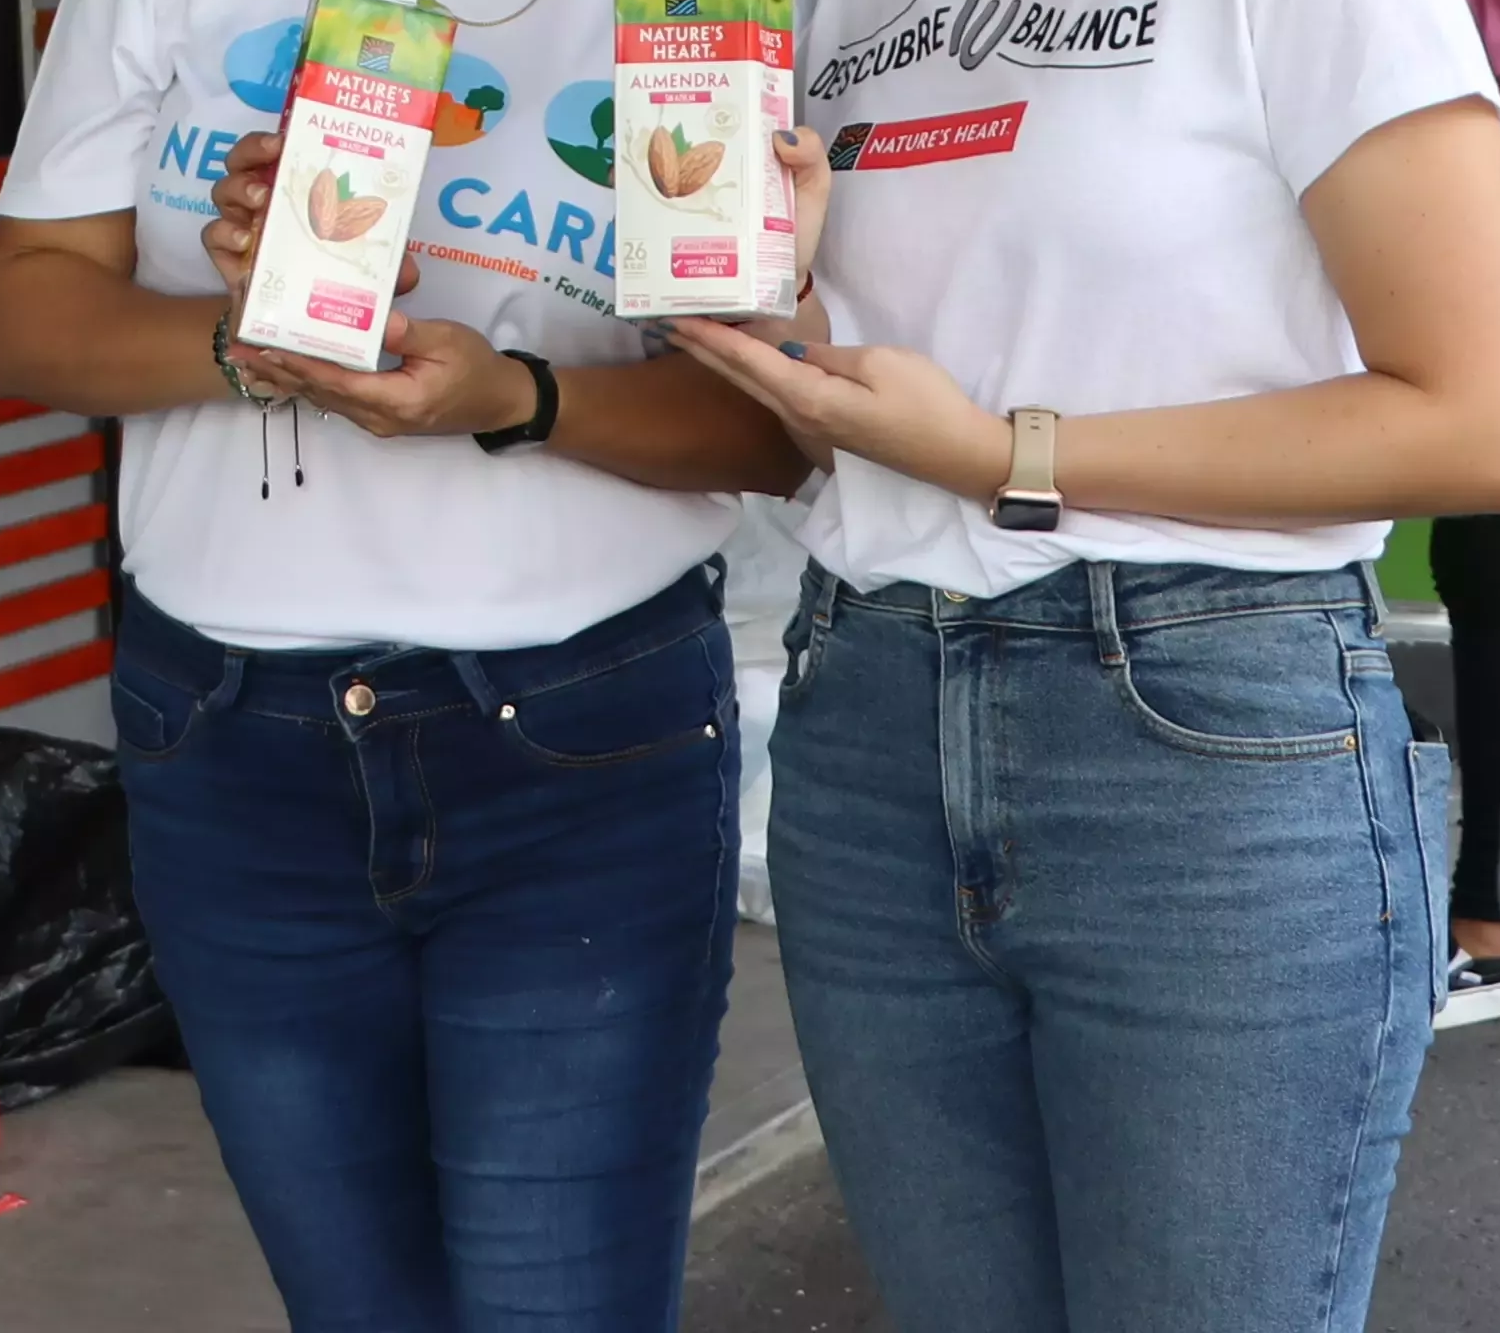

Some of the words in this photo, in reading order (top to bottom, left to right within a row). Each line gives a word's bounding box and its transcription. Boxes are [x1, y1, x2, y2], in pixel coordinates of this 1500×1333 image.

[639, 25, 724, 43] NATURE'S
[808, 5, 952, 101] DESCUBRE
[1010, 0, 1158, 54] BALANCE
[325, 70, 412, 105] NATURE'S
[630, 72, 730, 90] ALMENDRA
[307, 113, 406, 150] ALMENDRA
[868, 127, 951, 155] NATURE'S
[428, 243, 539, 283] communities
[623, 241, 647, 261] 26
[555, 275, 582, 299] For
[581, 288, 606, 312] the
